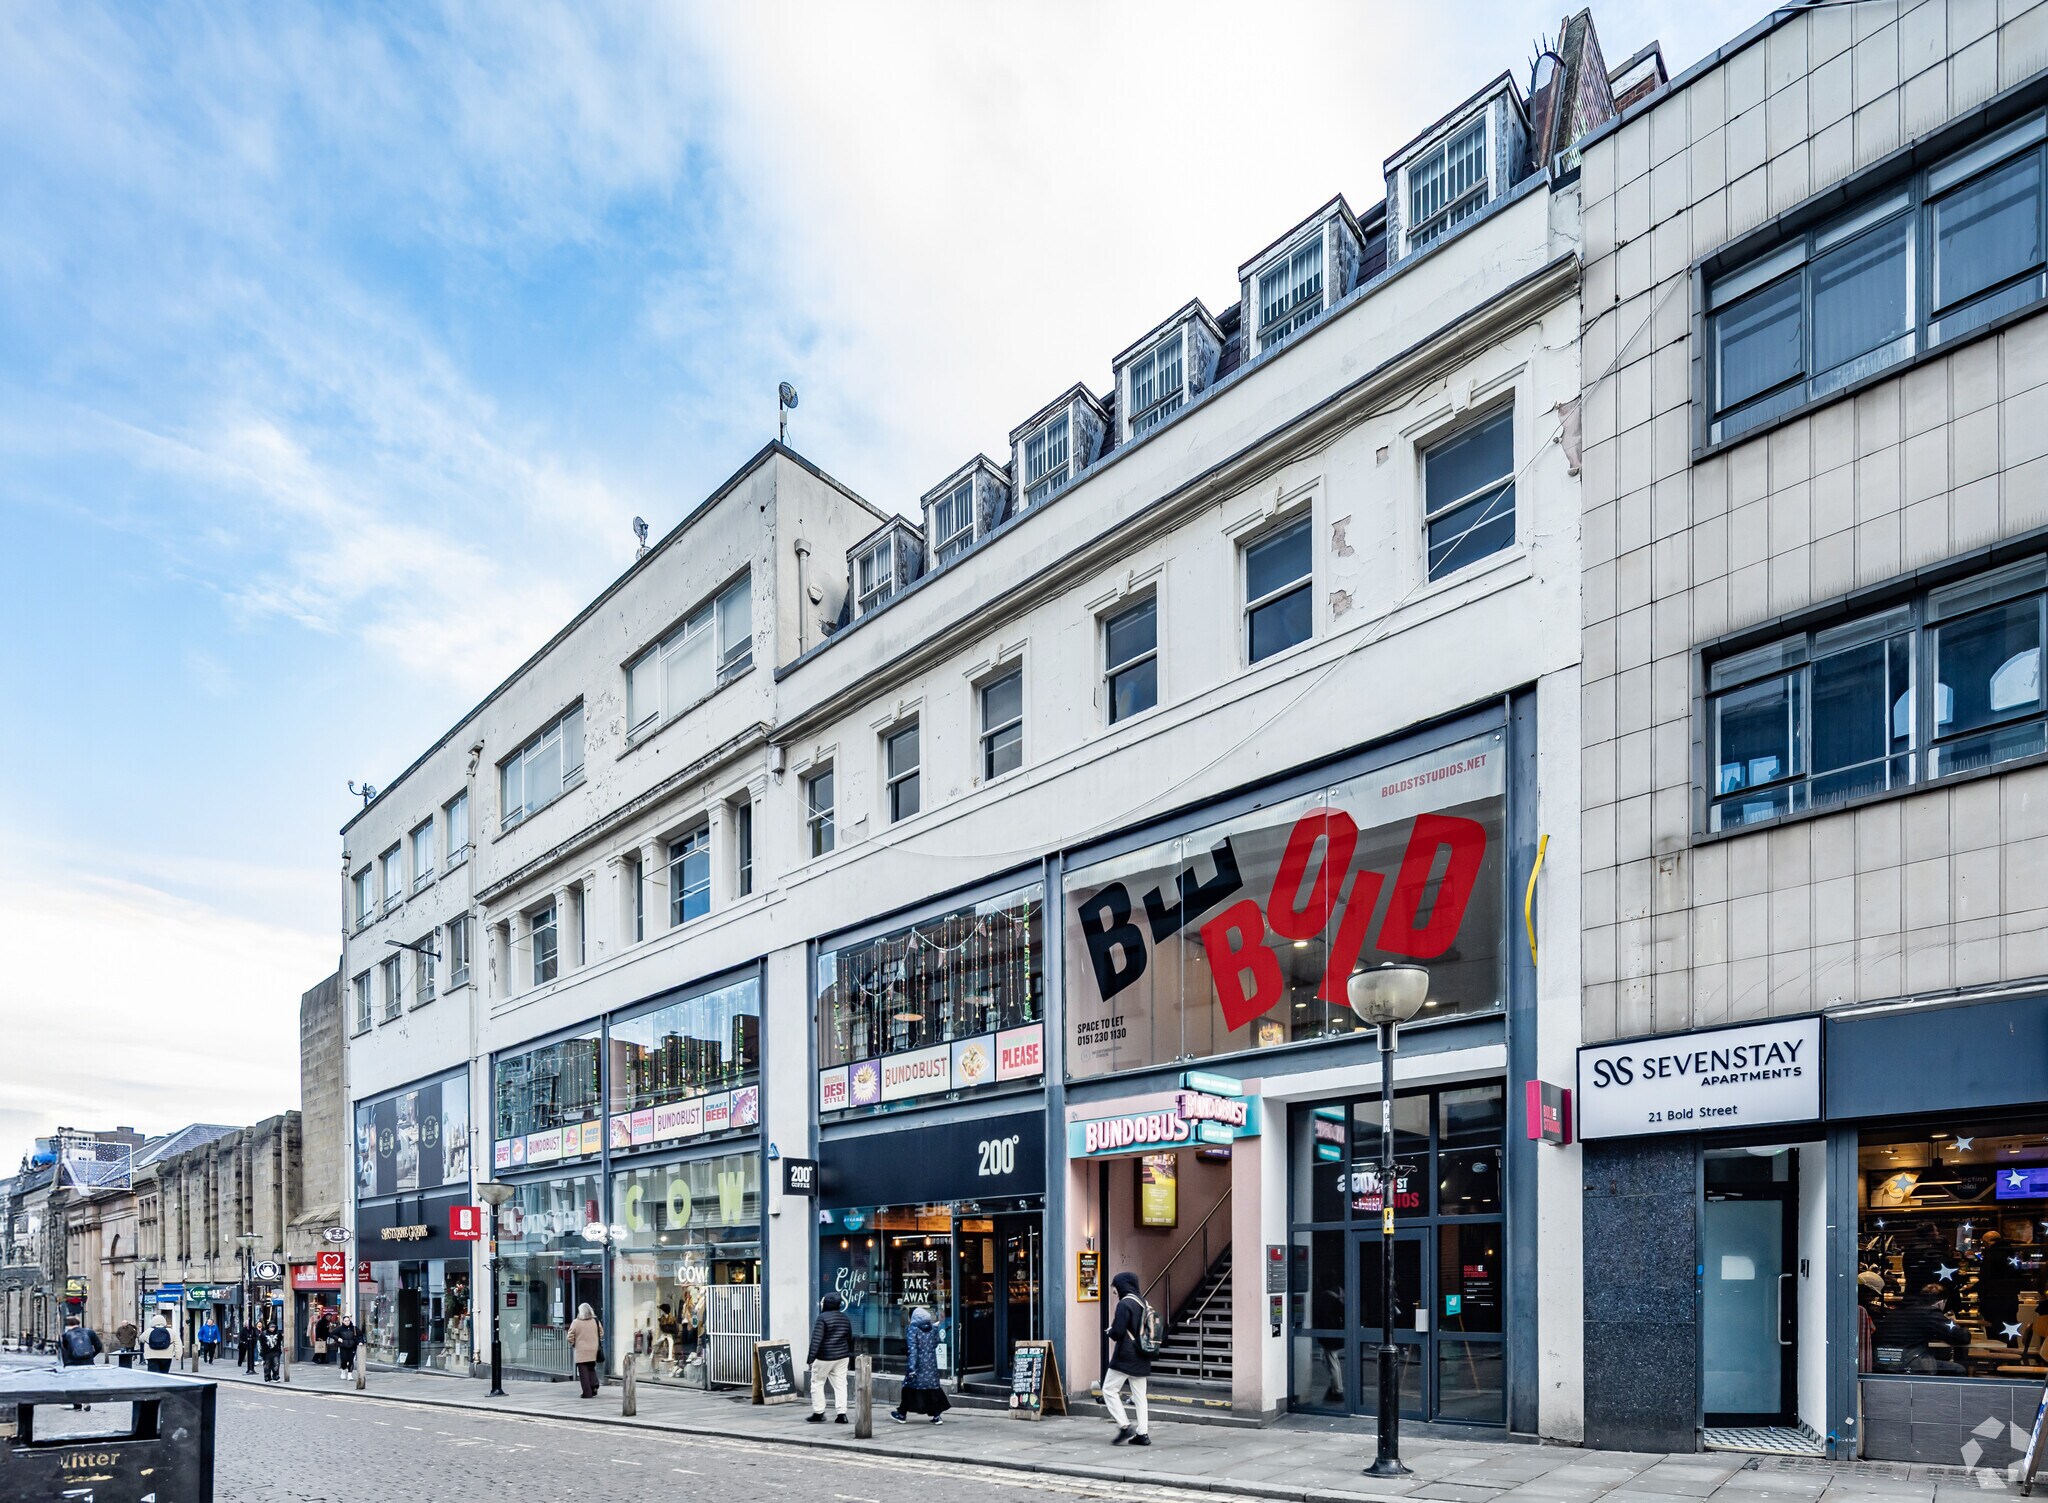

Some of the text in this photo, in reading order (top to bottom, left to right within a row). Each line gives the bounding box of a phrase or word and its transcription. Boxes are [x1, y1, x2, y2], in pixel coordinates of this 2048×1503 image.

[1382, 754, 1487, 798] BOLDSTSTUDIOS.NET
[1078, 807, 1487, 1033] BE BOLD
[1077, 1016, 1125, 1034] SPACE TO LET
[1078, 1028, 1127, 1046] 0151 230 1130
[1002, 1043, 1038, 1070] PLEASE
[1642, 1039, 1804, 1080] SEVENSTAY
[885, 1057, 947, 1088] BUNDOBUST
[1701, 1066, 1802, 1087] APARTMENTS
[824, 1082, 846, 1098] DESI
[706, 1102, 727, 1110] CRAFT
[824, 1095, 846, 1104] STYLE
[658, 1107, 700, 1132] BUNDOBUST
[706, 1108, 728, 1122] BEER
[1185, 1094, 1248, 1127] BUNDOBUST
[1648, 1104, 1738, 1123] 21 Bold Street
[584, 1135, 599, 1144] BEEF
[586, 1127, 598, 1136] NO
[633, 1125, 652, 1136] FOOD
[1086, 1111, 1199, 1153] BUNDOBUS
[529, 1136, 560, 1156] BUNDOBUST
[496, 1153, 509, 1162] SPICY
[1396, 1178, 1408, 1188] ST
[625, 1171, 745, 1231] COW
[678, 1266, 710, 1284] COW
[835, 1267, 868, 1292] Coffee
[903, 1278, 931, 1290] TAKE-
[840, 1288, 865, 1312] Shop
[903, 1292, 930, 1303] AWAY
